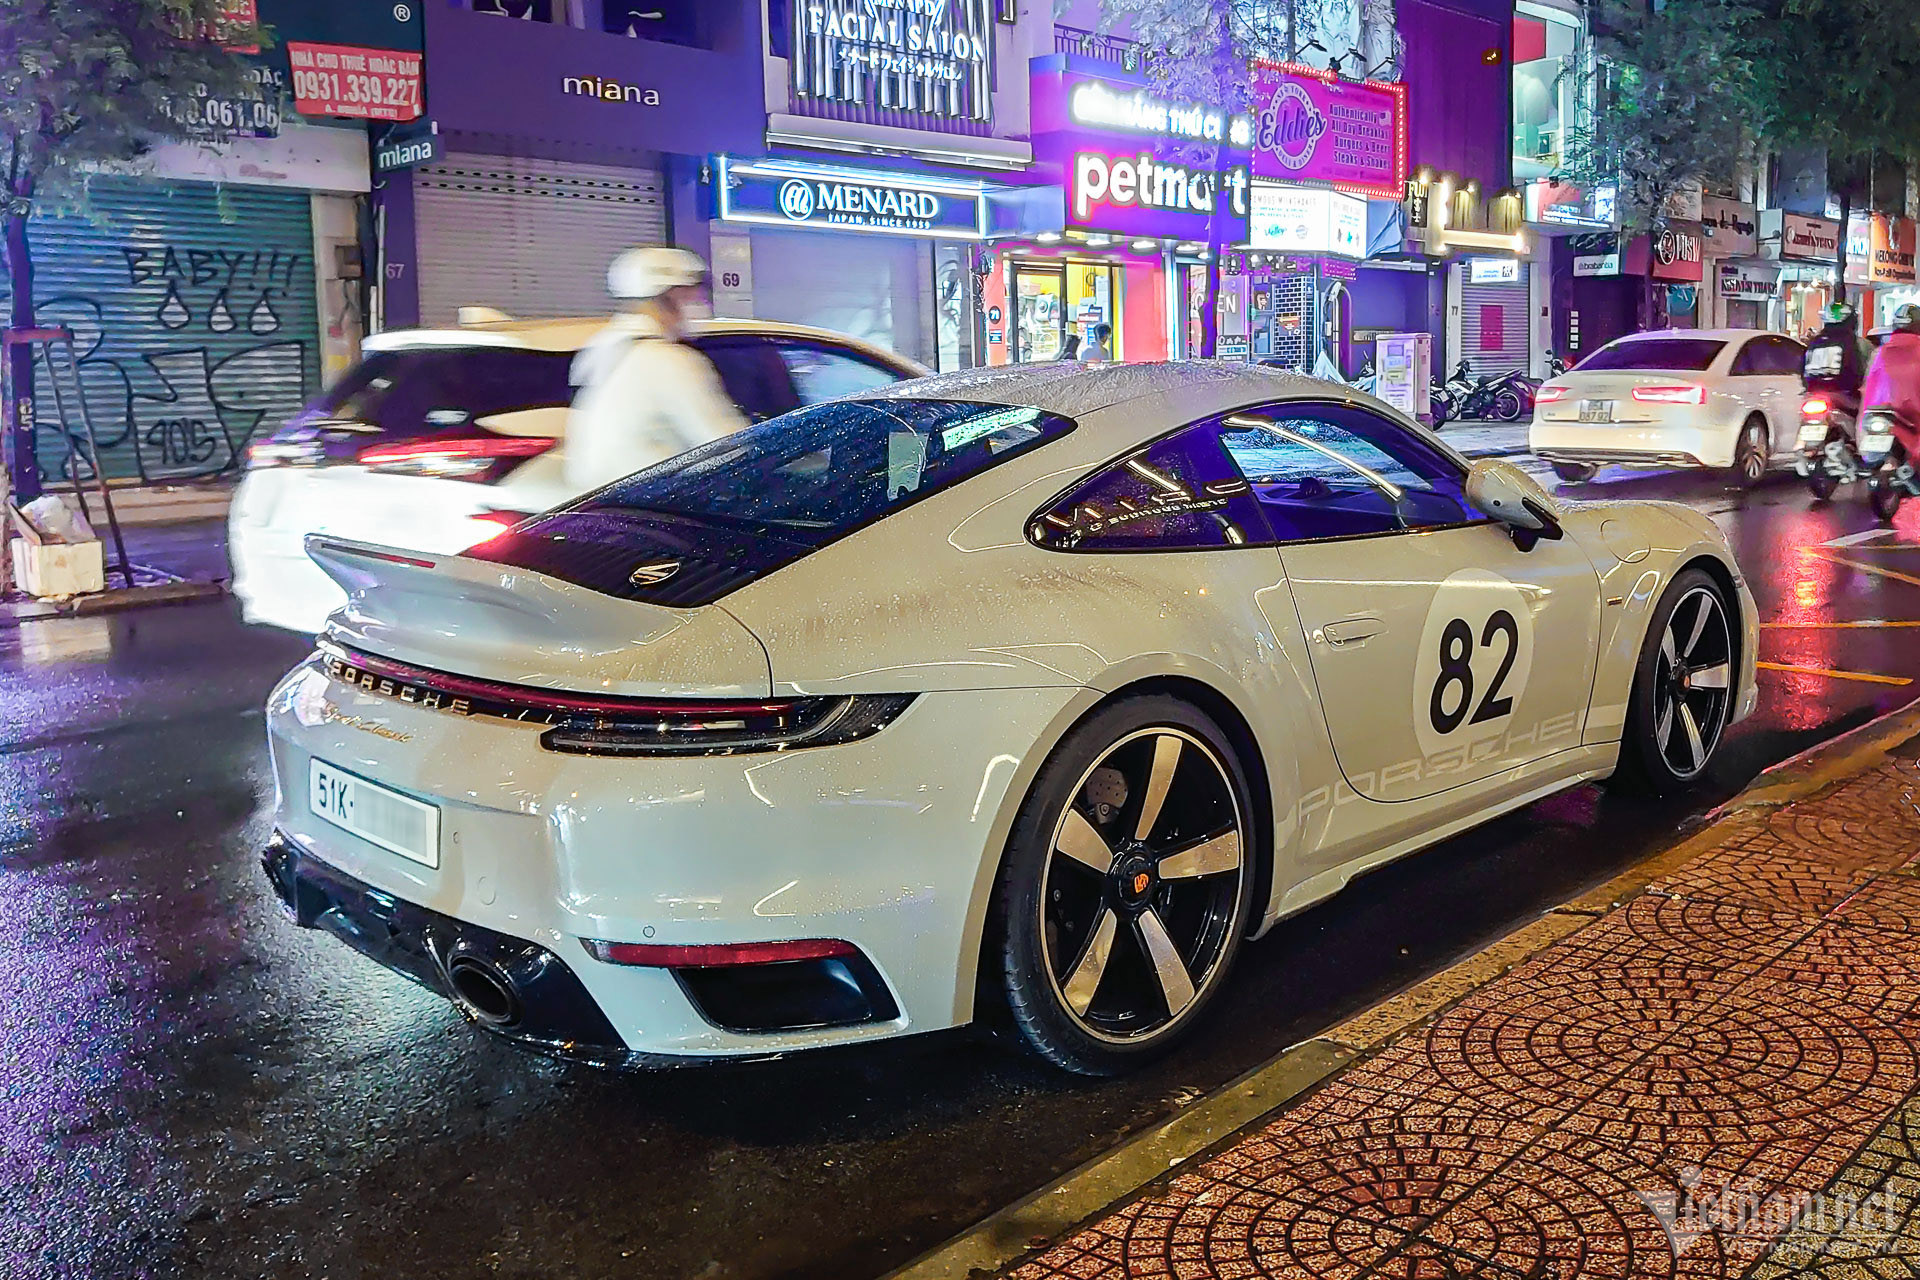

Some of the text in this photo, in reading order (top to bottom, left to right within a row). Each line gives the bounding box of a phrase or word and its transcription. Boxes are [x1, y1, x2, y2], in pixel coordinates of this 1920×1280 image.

[808, 6, 984, 62] FACIAL SALON
[294, 70, 418, 105] 0931.339.227
[563, 76, 661, 106] miana
[379, 142, 432, 169] miana
[816, 183, 939, 218] MENARD
[1076, 156, 1248, 217] petmat
[869, 216, 903, 229] SINCE
[905, 219, 931, 230] 1959
[385, 263, 405, 279] 67
[722, 273, 740, 287] 69
[1194, 293, 1237, 314] OEN
[329, 655, 469, 716] PORSCHE
[1430, 609, 1519, 735] 82
[1298, 711, 1576, 824] PORSCHE
